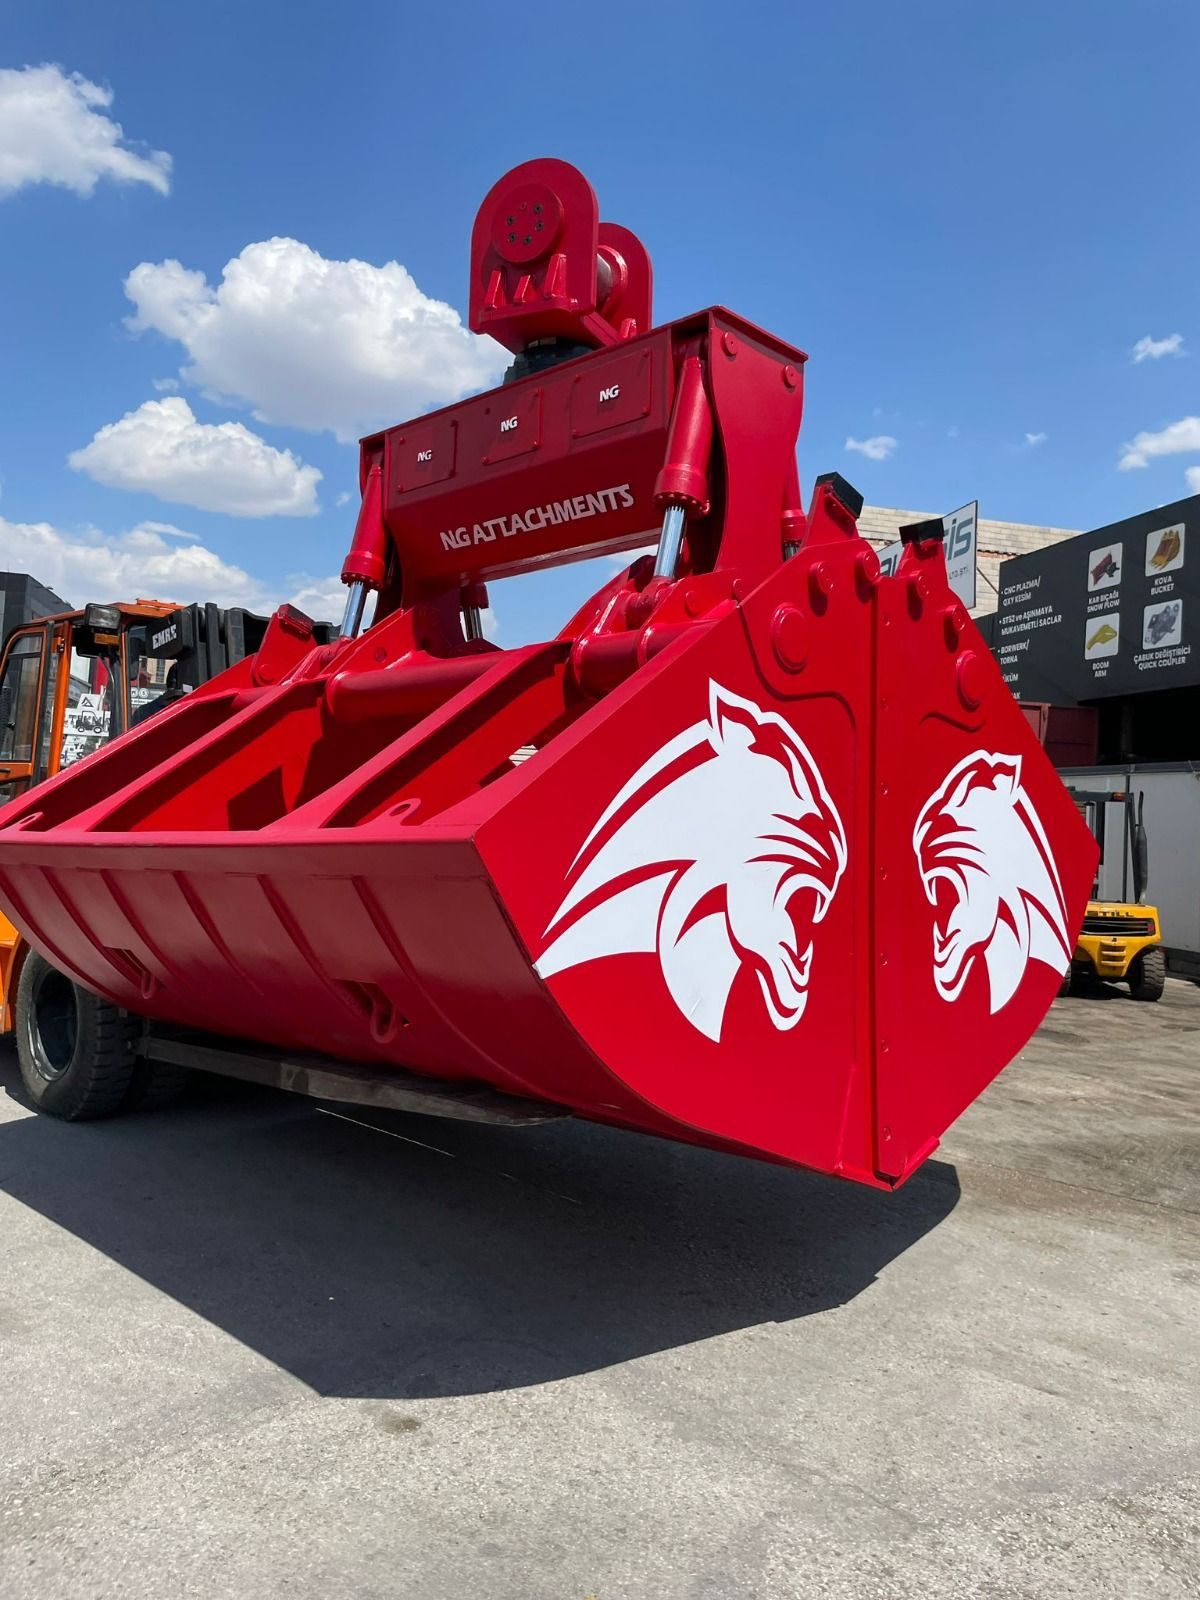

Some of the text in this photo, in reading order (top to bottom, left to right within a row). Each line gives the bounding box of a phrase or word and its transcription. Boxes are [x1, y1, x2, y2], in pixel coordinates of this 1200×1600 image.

[439, 484, 634, 551] NG ATTACHMENTS
[1154, 575, 1172, 586] KOVA
[1150, 583, 1174, 595] BUCKET
[1092, 661, 1110, 671] BOOM
[1138, 656, 1186, 671] QUICK COUPLER
[1094, 670, 1107, 678] ARM
